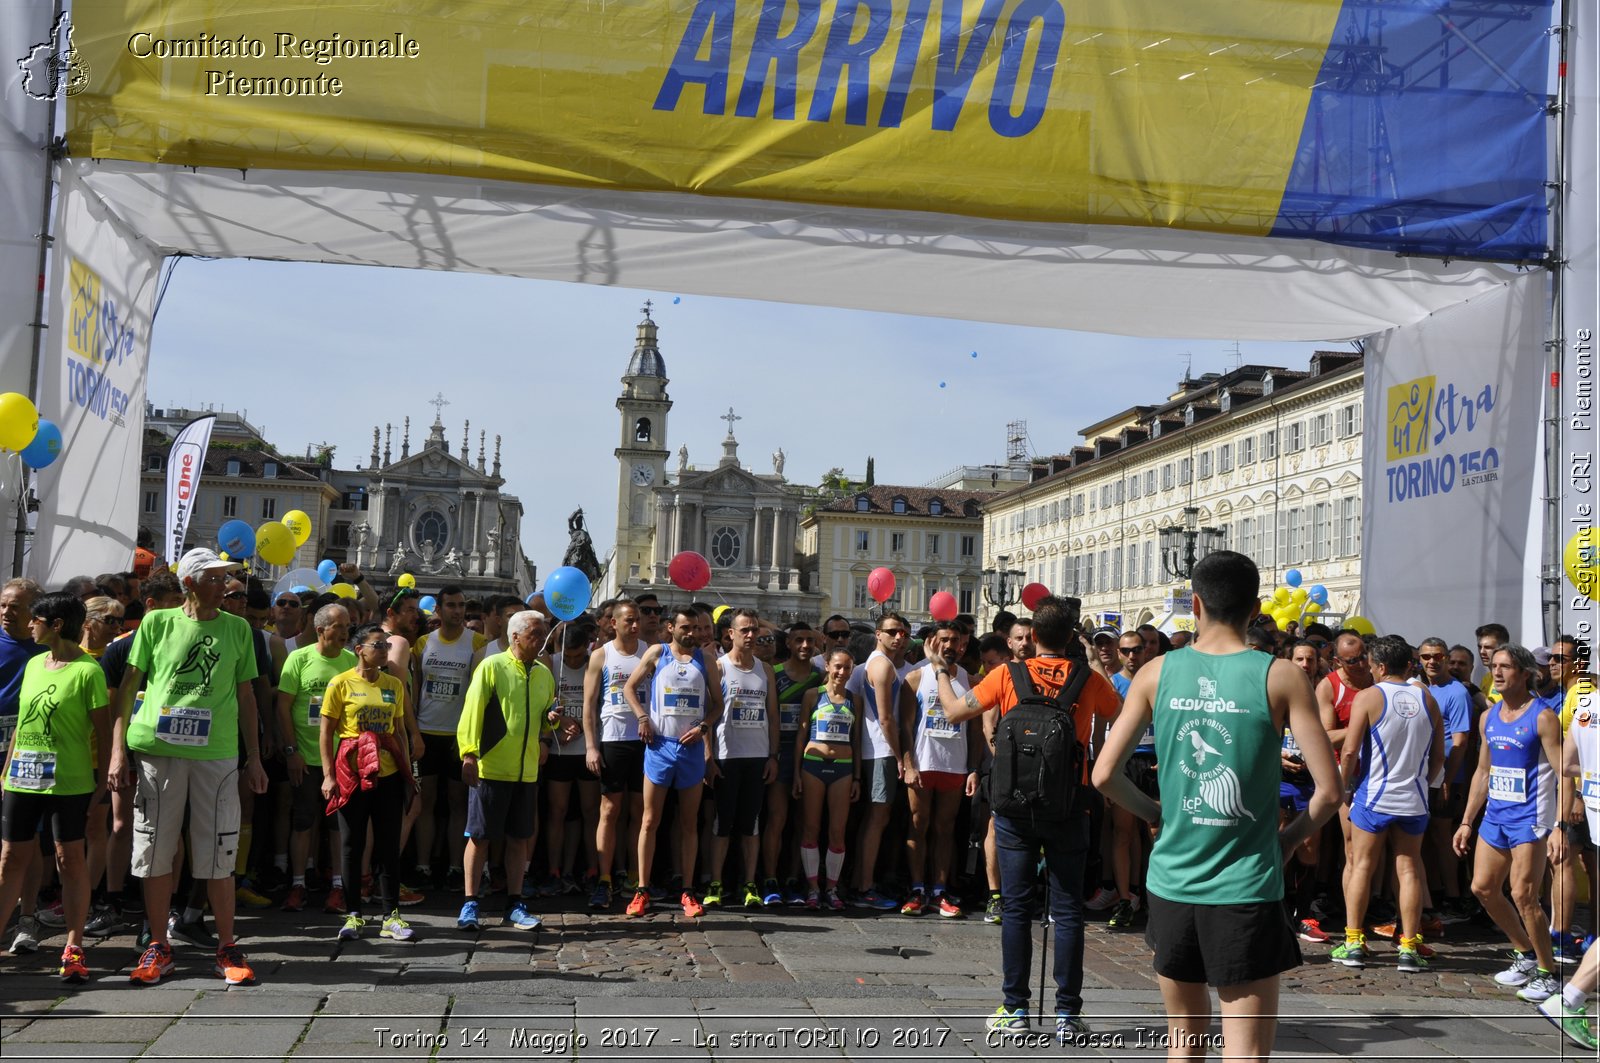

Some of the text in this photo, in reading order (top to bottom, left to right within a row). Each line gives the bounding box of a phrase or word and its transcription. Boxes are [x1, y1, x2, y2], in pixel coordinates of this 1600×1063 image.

[652, 0, 1066, 138] ARRIVO
[67, 357, 111, 420] TORINO
[1434, 383, 1499, 446] Stra
[1387, 447, 1499, 503] TORINO 150
[1462, 472, 1498, 487] LA STAMPA
[432, 681, 454, 695] 5888
[1170, 697, 1239, 713] ecoverde
[740, 710, 760, 720] 5879
[169, 718, 200, 736] 8131
[827, 724, 840, 733] 217
[1176, 718, 1233, 745] GRUPPO PODISTICO
[1179, 760, 1226, 780] PARCO APUANE
